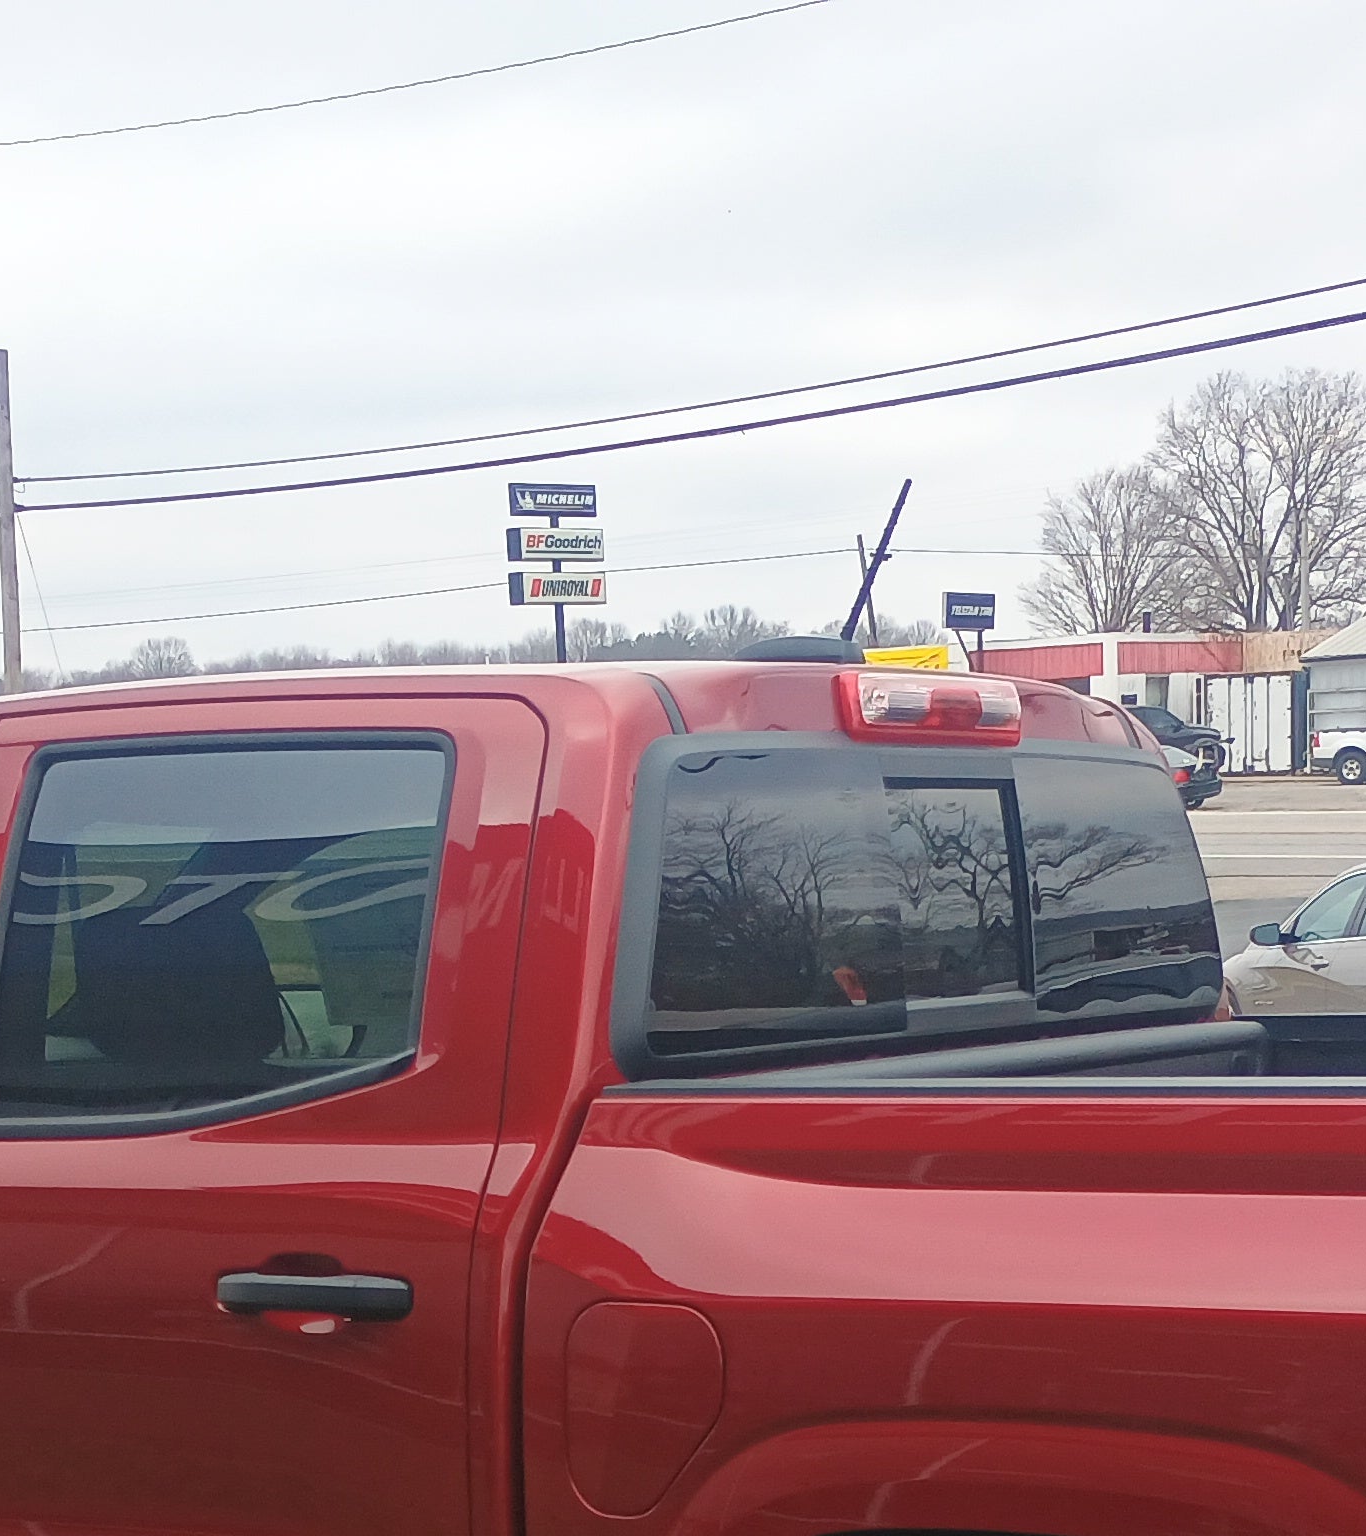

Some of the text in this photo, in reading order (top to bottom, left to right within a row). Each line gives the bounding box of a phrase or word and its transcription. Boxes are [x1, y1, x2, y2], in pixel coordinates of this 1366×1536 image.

[536, 493, 594, 505] MICHELIN
[526, 534, 602, 550] BFGoodrich
[542, 580, 589, 597] UNIROYAL
